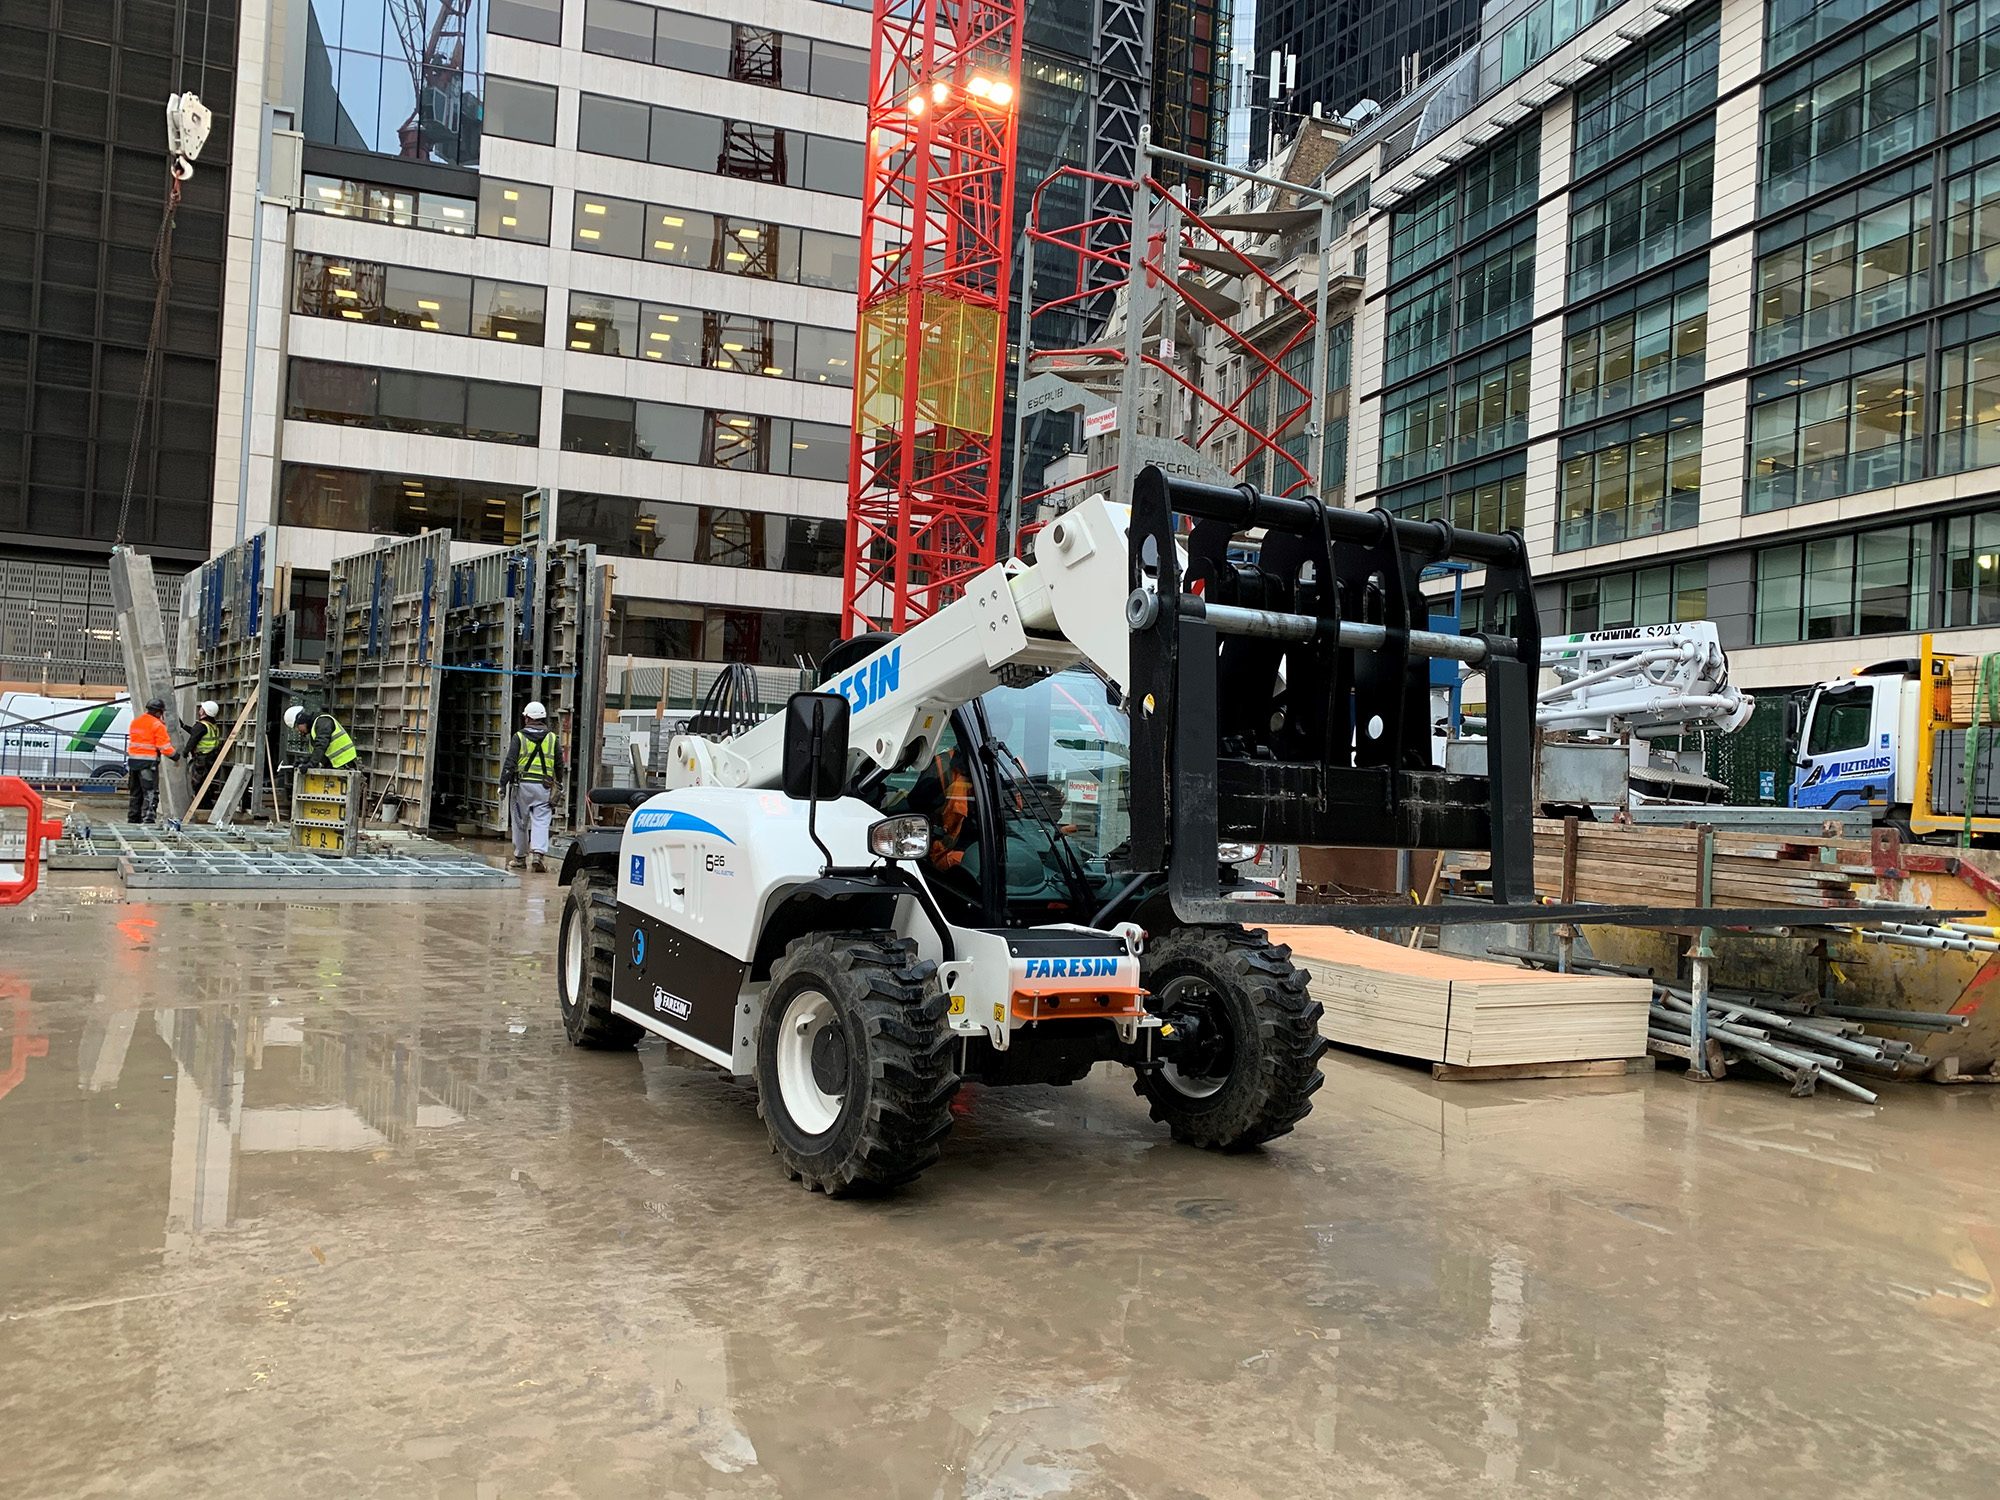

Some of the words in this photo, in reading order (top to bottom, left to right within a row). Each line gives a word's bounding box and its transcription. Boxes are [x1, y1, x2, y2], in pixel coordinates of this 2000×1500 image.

[1086, 410, 1115, 426] Honeywell
[826, 645, 902, 715] ESIN
[635, 813, 674, 828] FARESIN
[1024, 958, 1118, 979] FARESIN
[662, 995, 687, 1017] FARESIN
